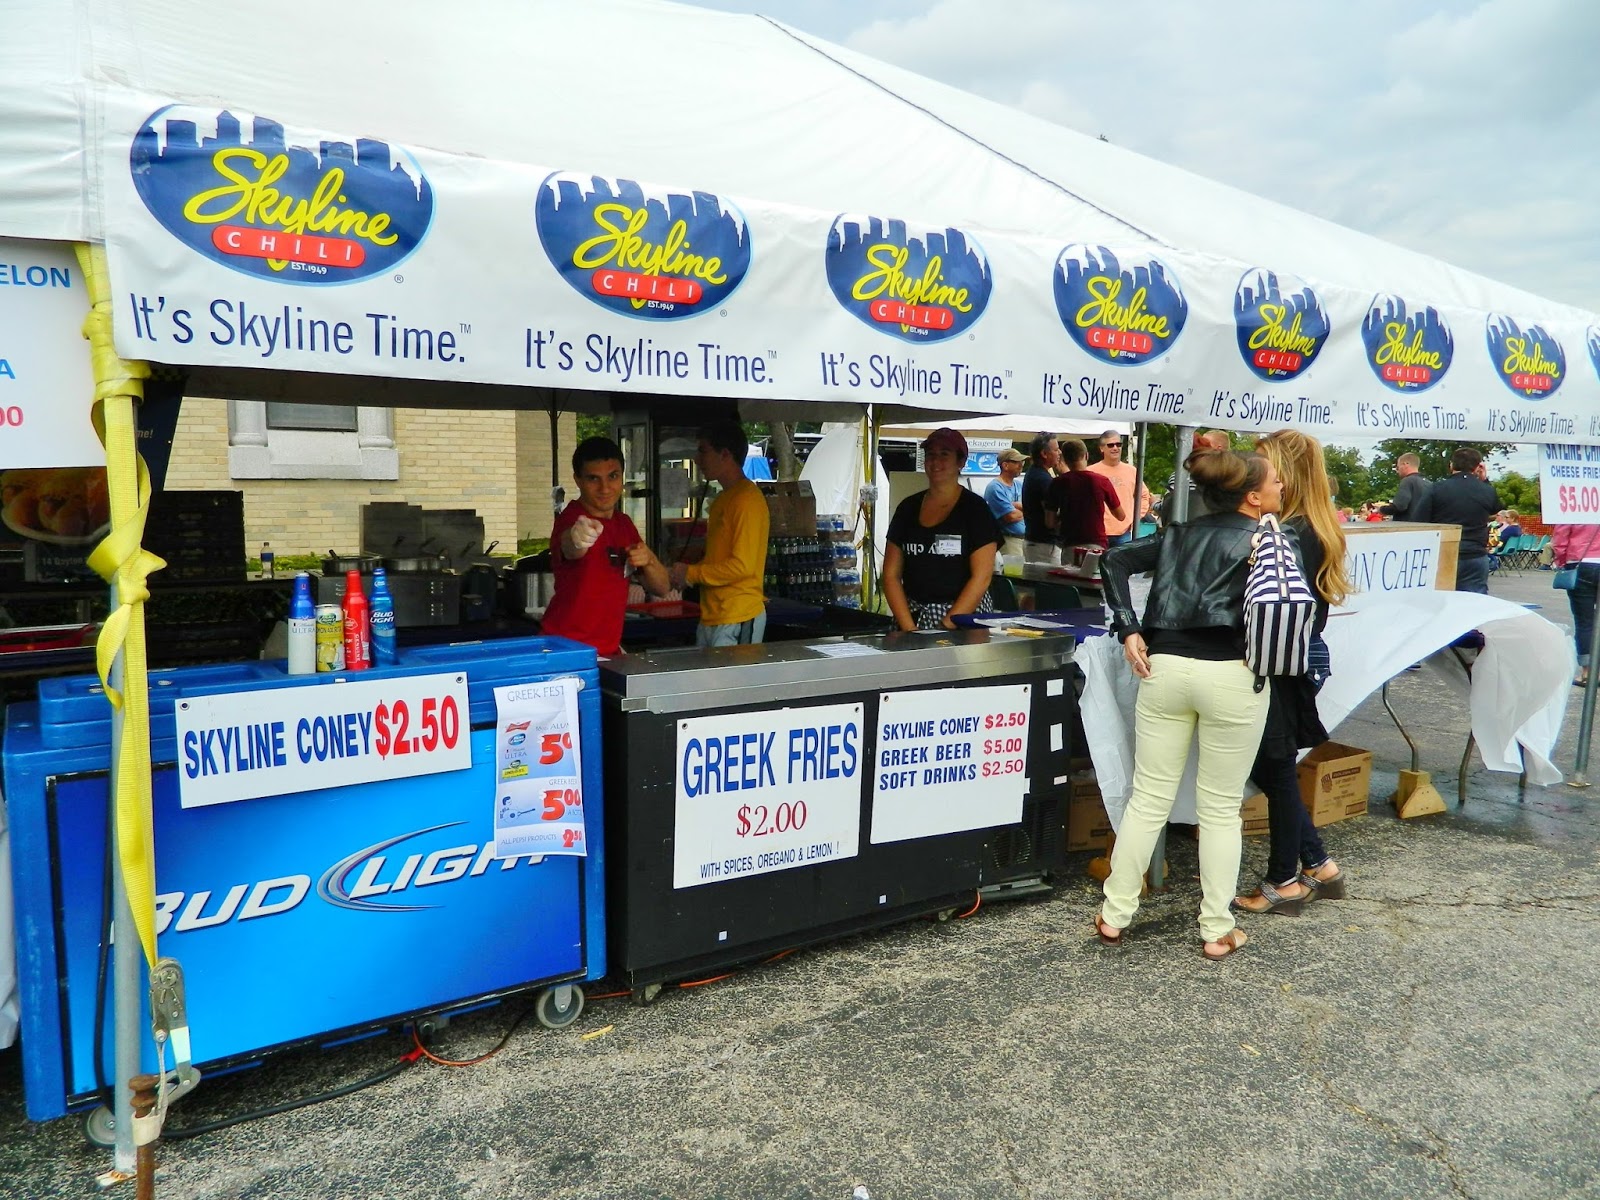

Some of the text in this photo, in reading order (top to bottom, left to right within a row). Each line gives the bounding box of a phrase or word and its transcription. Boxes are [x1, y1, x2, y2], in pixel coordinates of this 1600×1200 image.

[184, 148, 399, 272] Skyline
[227, 231, 351, 261] CHILI
[573, 203, 727, 309] Skyline
[603, 275, 692, 298] CHILI
[852, 244, 972, 333] Skyline
[130, 293, 194, 343] It's
[210, 299, 353, 358] Skyline
[366, 312, 465, 362] Time.
[878, 304, 945, 324] CHILI
[1075, 276, 1170, 357] Skyline
[526, 328, 574, 370] It's
[585, 333, 689, 383] Skyline
[698, 343, 773, 383] Time.
[1093, 331, 1147, 348] CHILI
[1248, 304, 1316, 375] Skyline
[1375, 322, 1442, 388] Skyline
[821, 352, 861, 387] It's
[869, 354, 941, 396] Skyline
[950, 363, 1008, 399] Time.
[1258, 352, 1299, 367] CHILI
[1386, 367, 1426, 379] CHILI
[1503, 337, 1560, 394] Skyline
[1043, 373, 1072, 405] It's
[1078, 377, 1140, 414] Skyline
[1146, 384, 1184, 414] Time.
[1515, 375, 1549, 386] CHILI
[1210, 390, 1334, 426] It's Skyline Time.
[1357, 401, 1468, 433] It's Skyline Time.
[1487, 409, 1506, 432] It's
[1509, 410, 1547, 437] Skyline
[1550, 464, 1580, 478] CHEESE
[1559, 483, 1599, 515] $5.00
[1381, 548, 1431, 591] CAFE
[370, 616, 395, 624] LIGHT
[506, 685, 565, 702] GREEK FEST
[184, 694, 459, 779] SKYLINE CONEY $2.50
[882, 711, 1026, 742] SKYLINE CONEY $2.50
[505, 751, 527, 759] ULTRA
[683, 722, 858, 799] GREEK FRIES
[880, 737, 1022, 768] GREEK BEER $5.00
[879, 759, 1024, 791] SOFT DRINKS $2.50
[736, 801, 807, 838] $2.00
[501, 838, 512, 846] ALL
[527, 834, 557, 842] PRODUCTS
[349, 841, 545, 899] LIGH
[700, 861, 722, 879] WITH
[723, 854, 755, 875] SPICES,
[757, 848, 796, 868] OREGANO
[797, 847, 804, 861] &
[806, 842, 833, 860] LEMON
